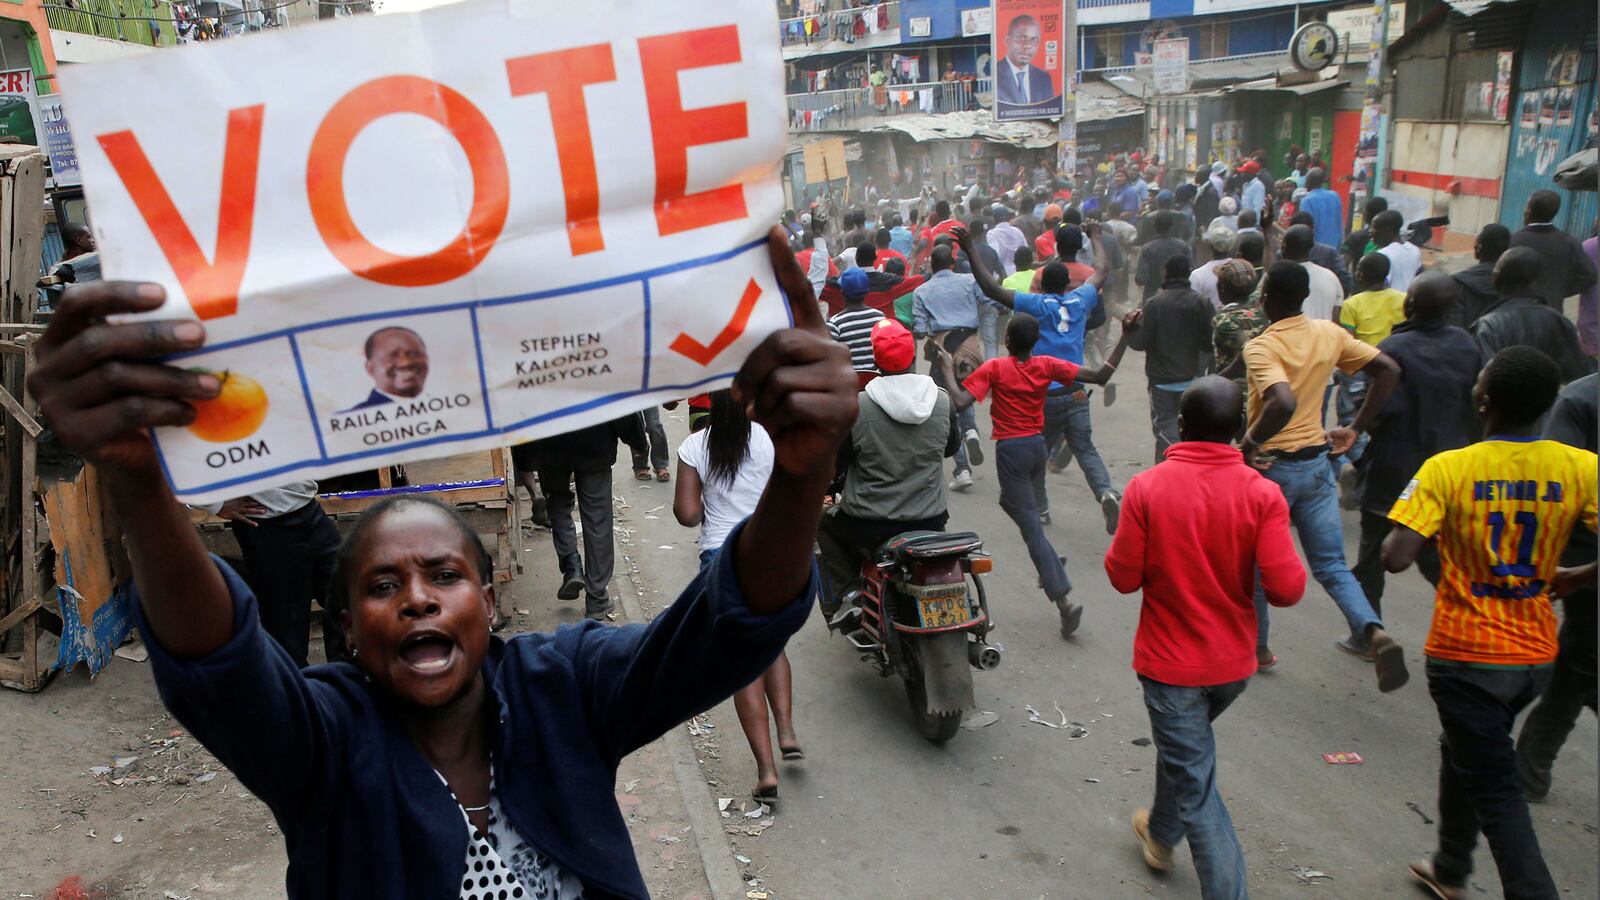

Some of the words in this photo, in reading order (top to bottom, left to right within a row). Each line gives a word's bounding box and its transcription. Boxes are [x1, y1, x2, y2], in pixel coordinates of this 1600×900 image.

[95, 24, 749, 321] VOTE
[1057, 306, 1069, 333] 1
[520, 332, 601, 353] STEPHEN
[515, 347, 608, 375] KALONZO
[518, 364, 612, 389] MUSYOKA
[330, 410, 387, 432] RAILA
[395, 393, 471, 420] AMOLO
[362, 419, 448, 446] ODINGA
[206, 440, 271, 469] ODM
